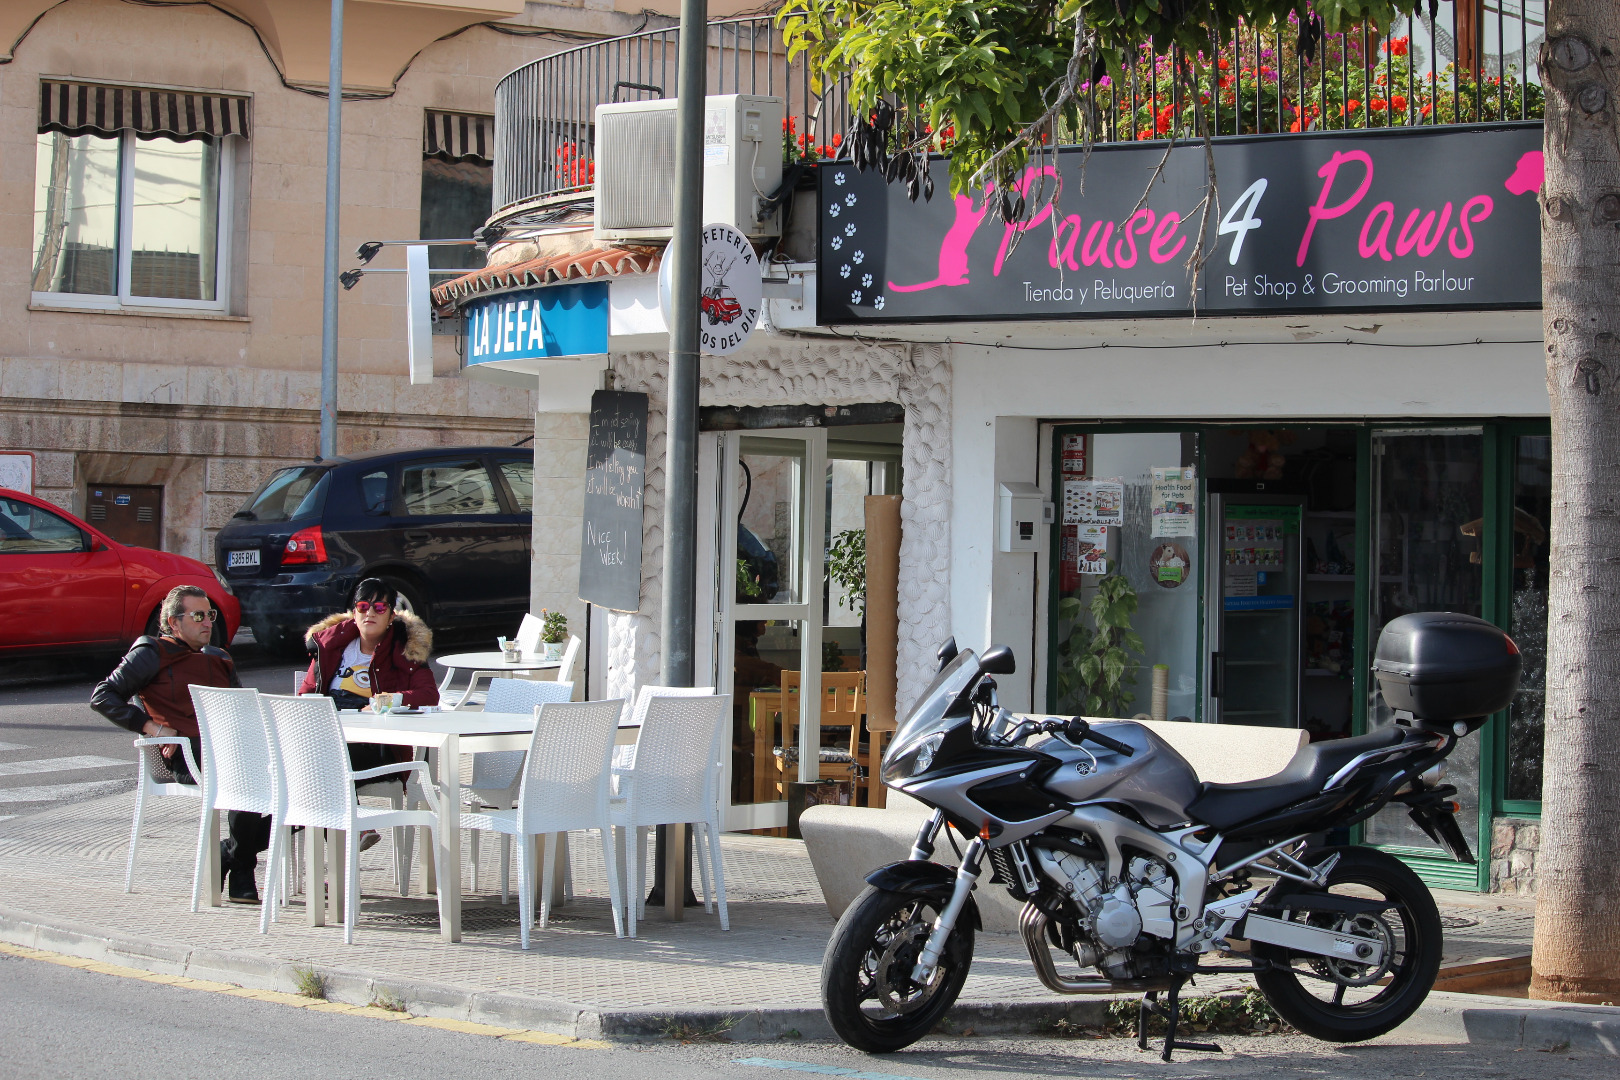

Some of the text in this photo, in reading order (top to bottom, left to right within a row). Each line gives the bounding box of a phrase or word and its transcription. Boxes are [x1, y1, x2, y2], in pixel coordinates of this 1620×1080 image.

[993, 149, 1494, 277] Pause 4 Paws
[1023, 280, 1074, 302] Tienda
[1079, 287, 1088, 305] y
[1094, 279, 1175, 303] Peluquería
[1225, 275, 1247, 297] Pet
[1253, 274, 1296, 300] Shop
[1302, 274, 1316, 295] &
[1322, 272, 1408, 297] Grooming
[1414, 269, 1475, 292] Parlour
[474, 299, 544, 356] LA JEFA
[721, 332, 741, 349] DEL
[742, 307, 756, 333] DÍA
